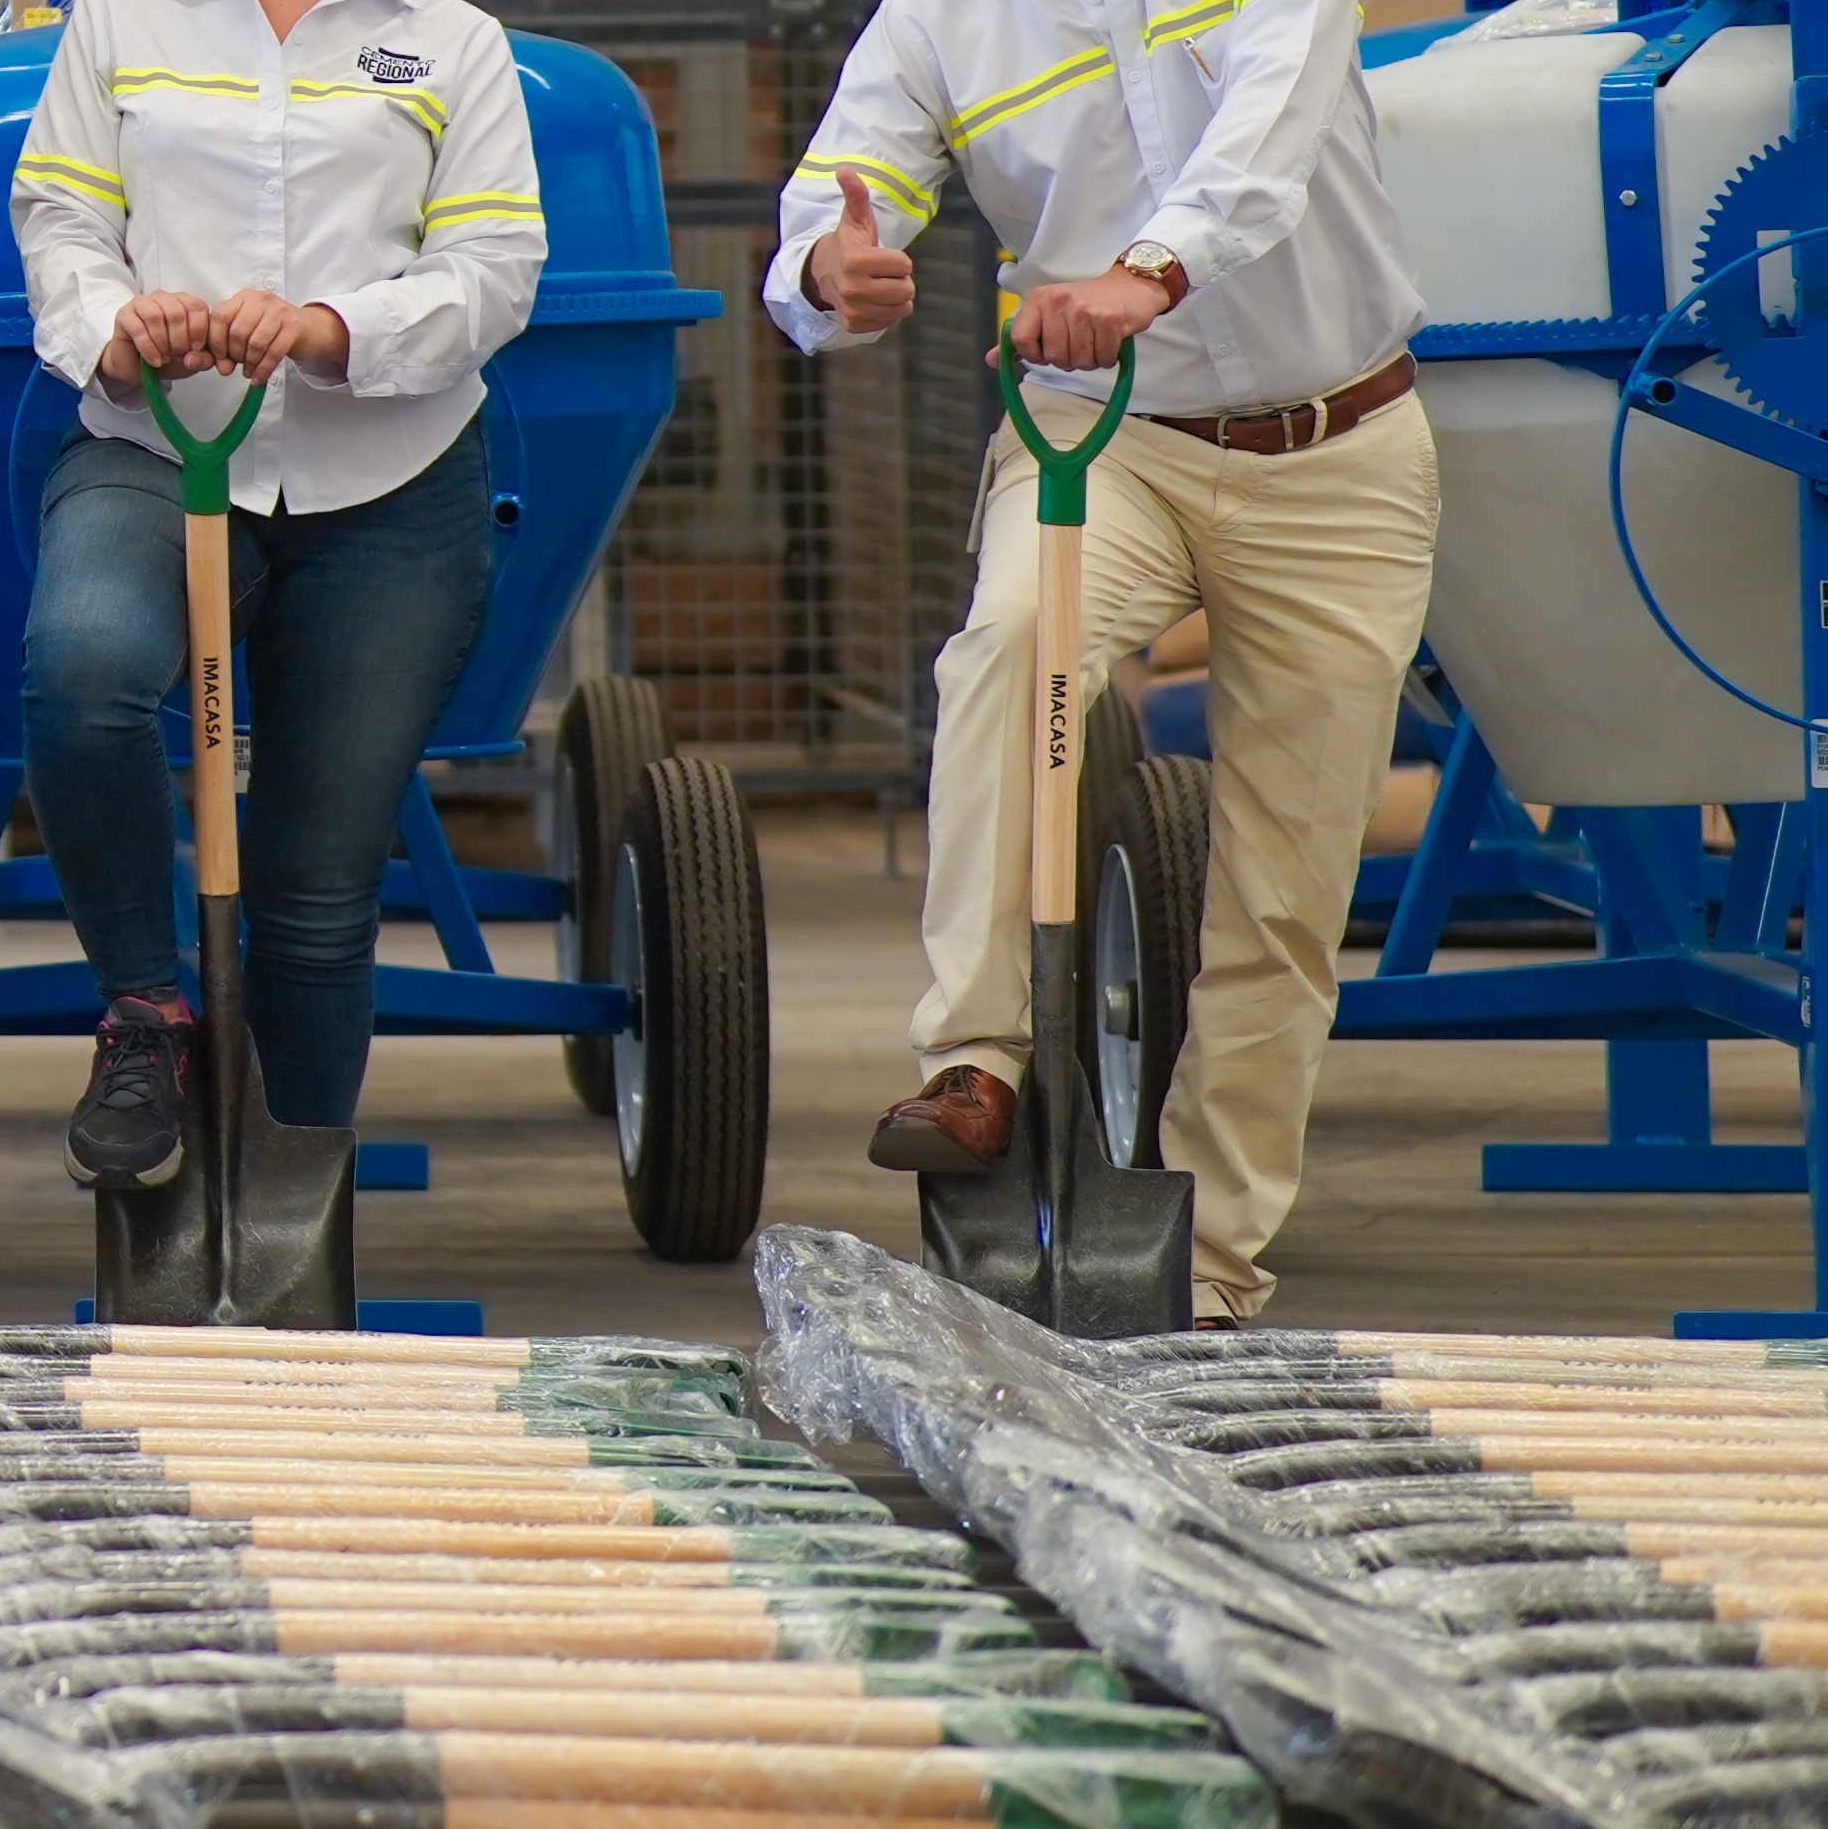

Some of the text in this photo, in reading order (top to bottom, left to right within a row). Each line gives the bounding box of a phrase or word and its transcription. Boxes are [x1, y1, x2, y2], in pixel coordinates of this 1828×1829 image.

[356, 53, 434, 79] REGIONAL
[360, 45, 436, 67] CEMENTO
[203, 657, 222, 750] IMACASA
[1049, 674, 1067, 769] IMACASA
